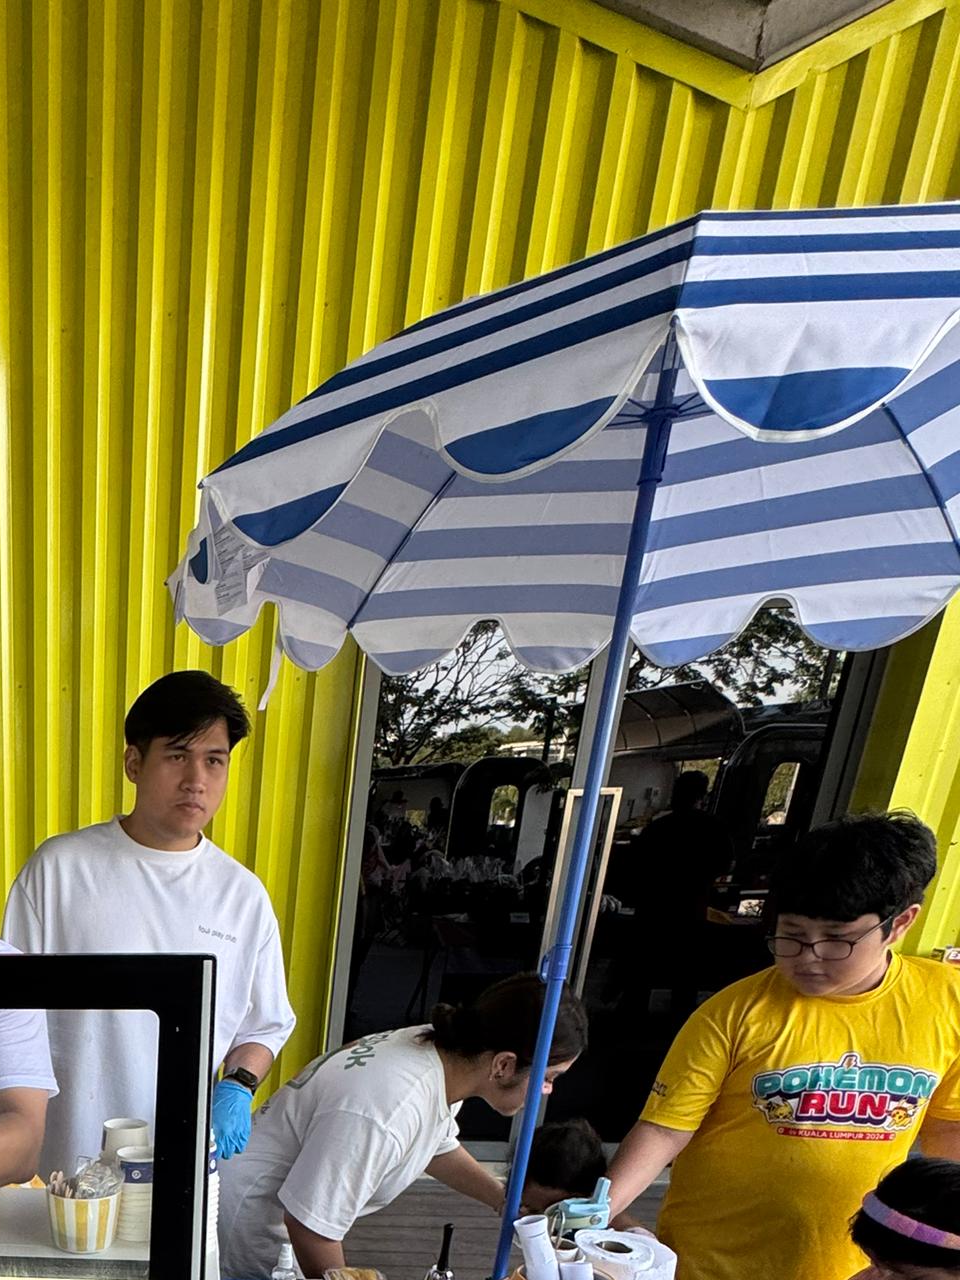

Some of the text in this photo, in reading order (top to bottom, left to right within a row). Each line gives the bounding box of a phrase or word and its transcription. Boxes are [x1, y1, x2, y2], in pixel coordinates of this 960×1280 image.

[799, 1092, 888, 1118] RUN
[799, 1129, 827, 1138] KUALA
[829, 1131, 864, 1140] LUMPUR
